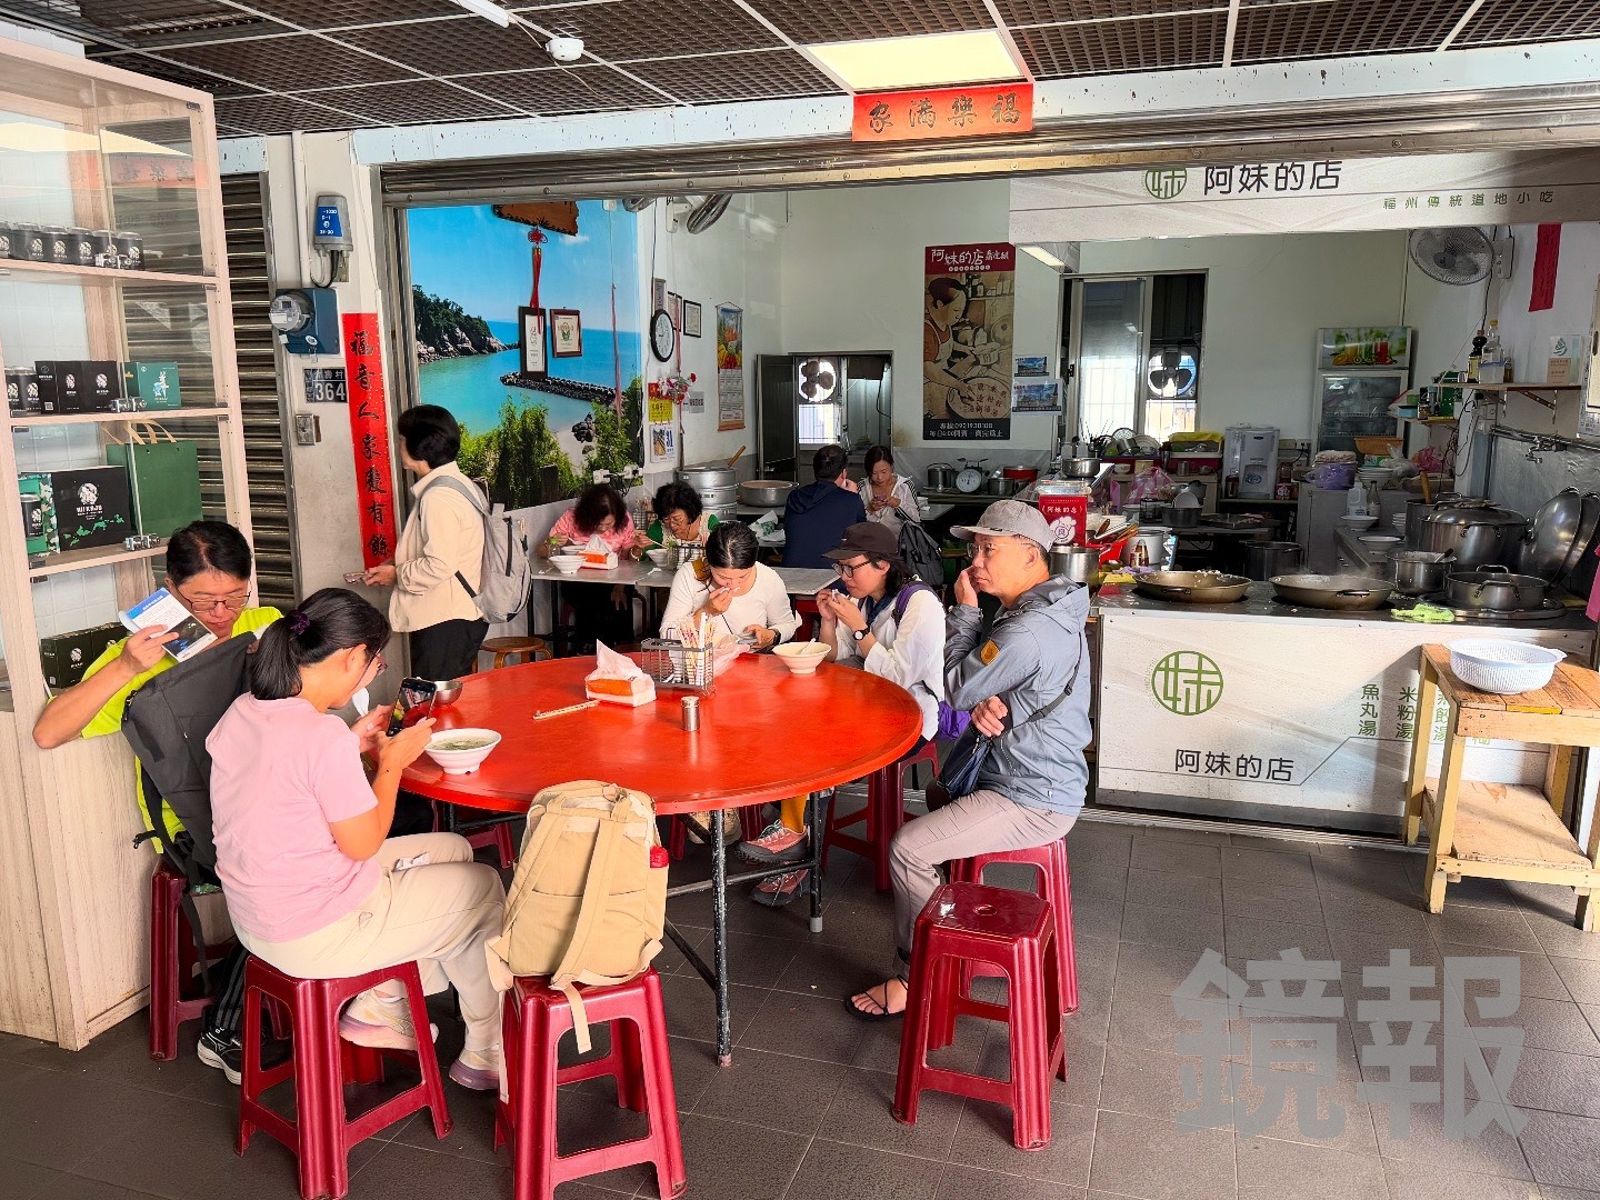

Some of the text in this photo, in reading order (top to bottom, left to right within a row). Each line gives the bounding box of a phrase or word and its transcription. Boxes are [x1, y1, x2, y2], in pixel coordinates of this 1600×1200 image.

[1204, 160, 1343, 196] 阿妹的店
[1382, 191, 1554, 210] 福州傳統道地小吃
[931, 248, 984, 266] 阿妹的店
[315, 382, 346, 401] 364
[1358, 683, 1380, 737] 魚丸湯
[1395, 686, 1418, 740] 米粉湯
[1174, 748, 1295, 782] 阿妹的店
